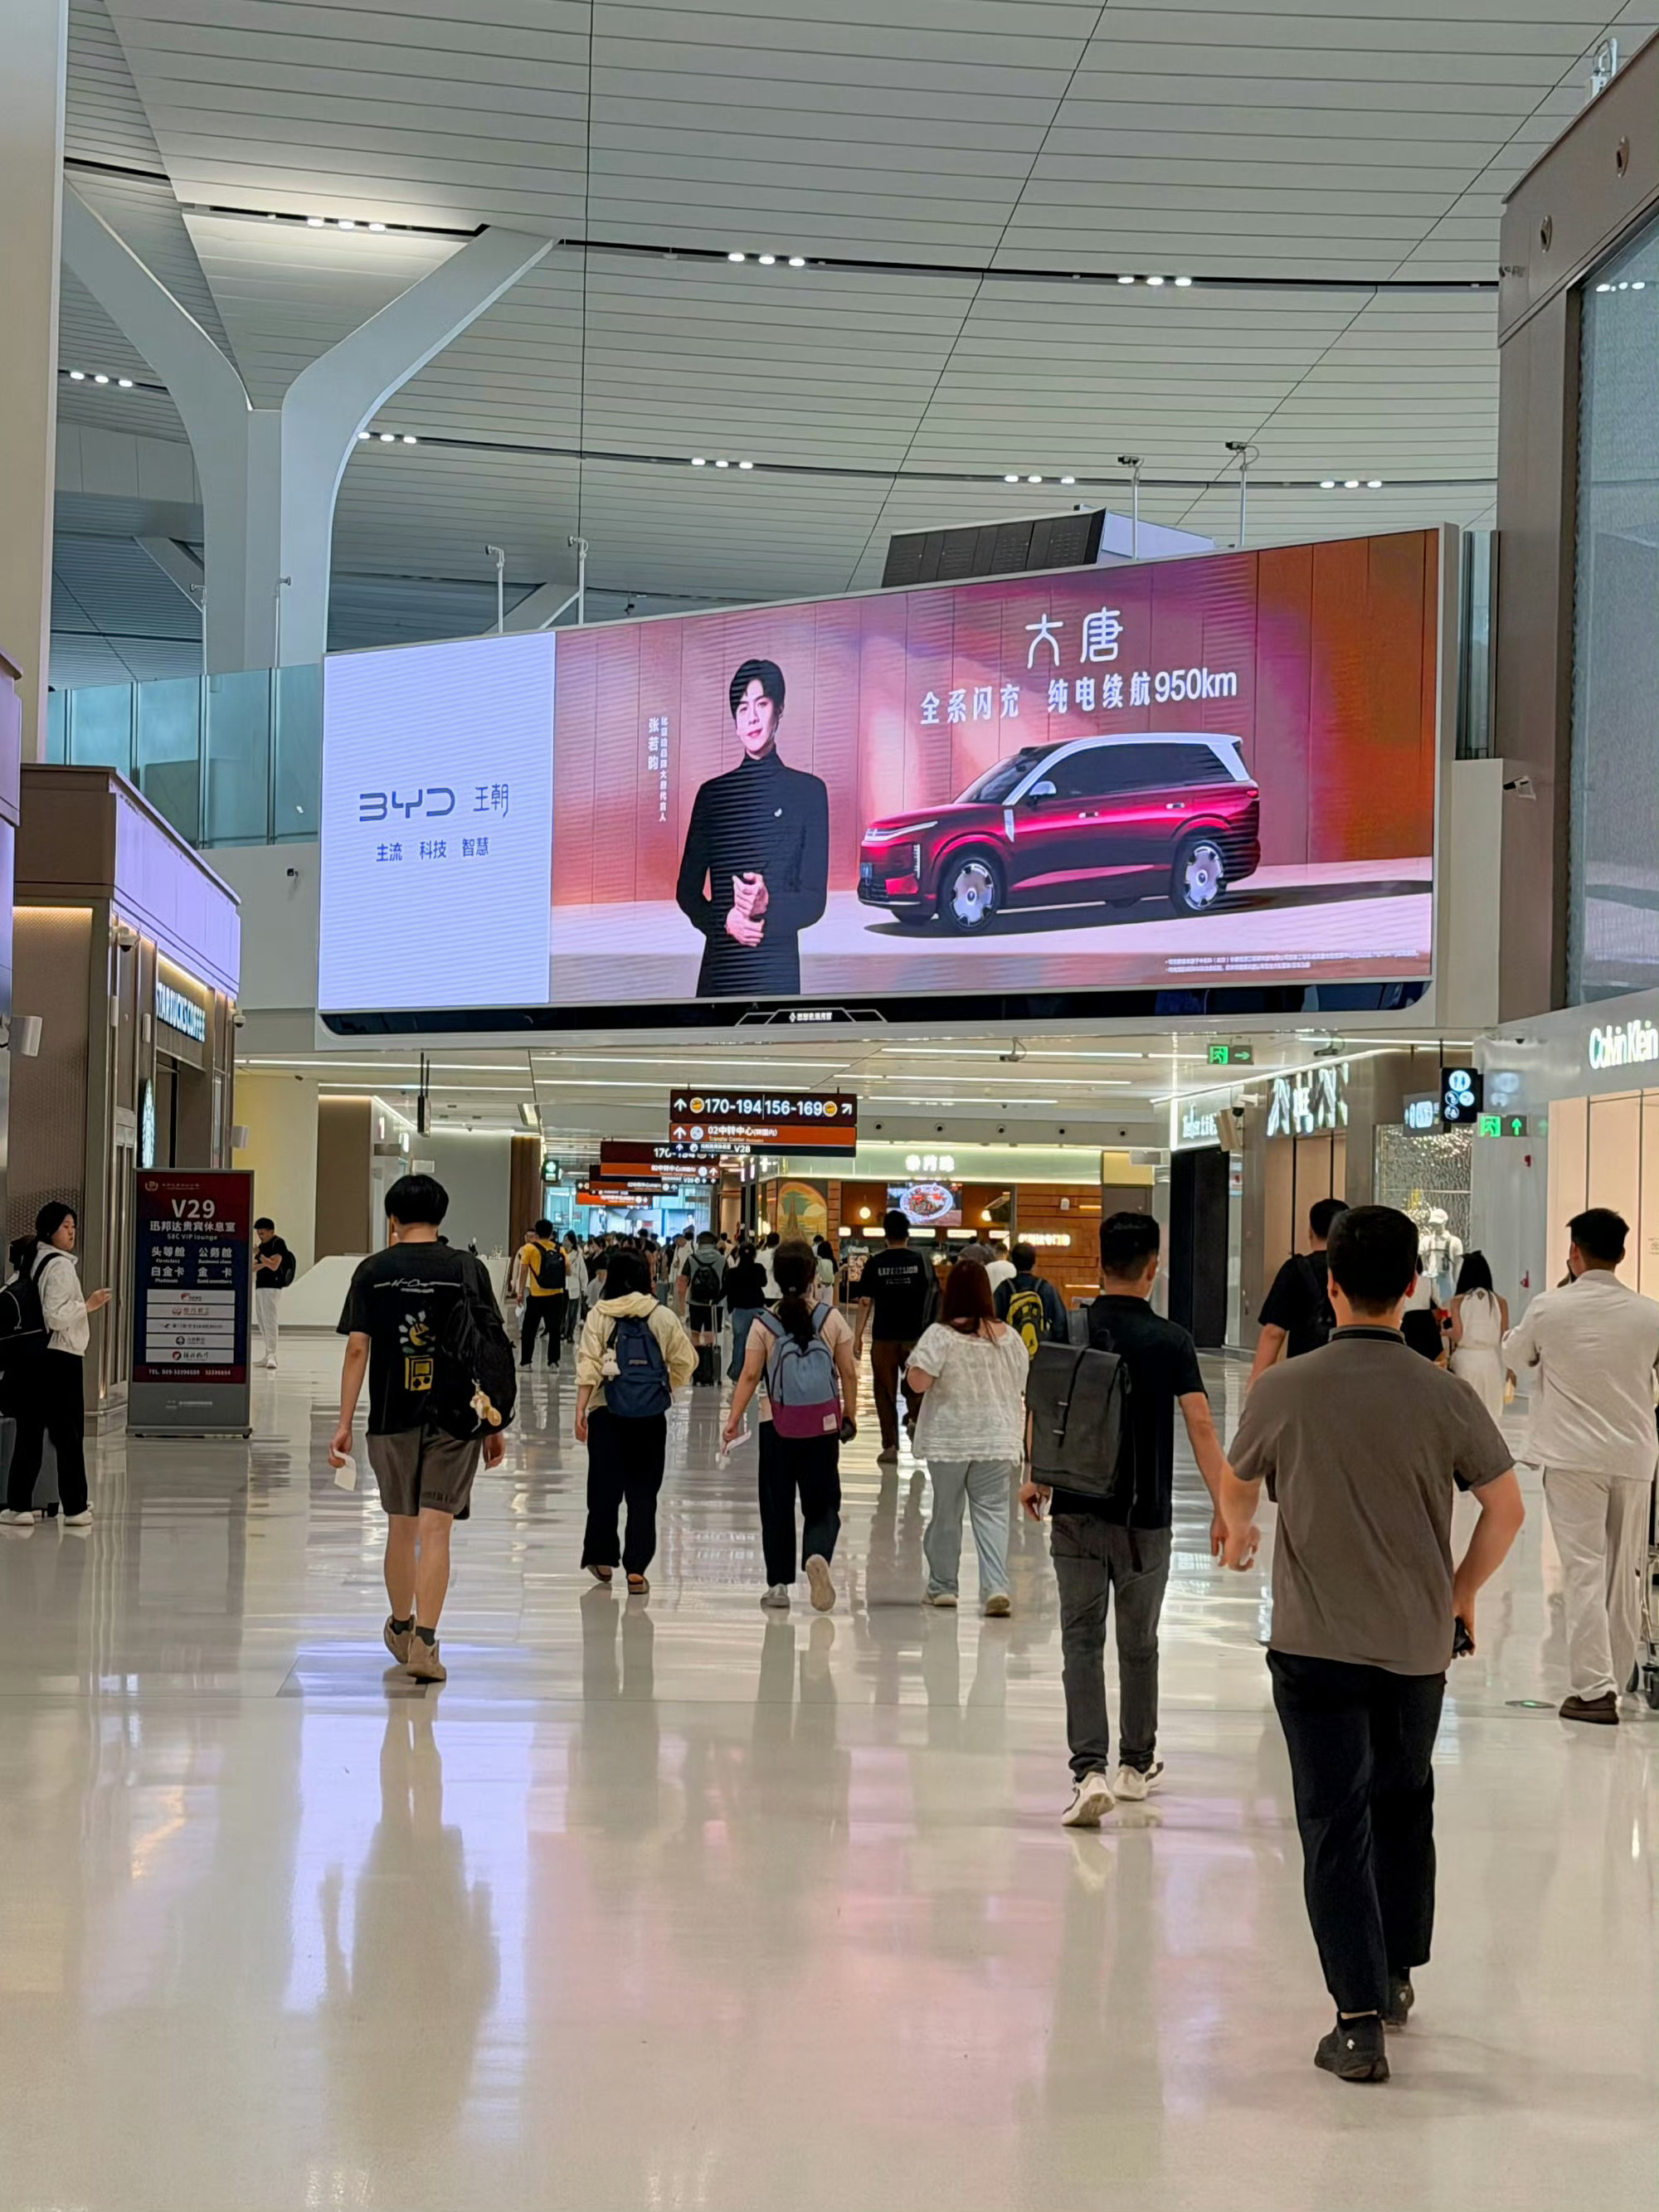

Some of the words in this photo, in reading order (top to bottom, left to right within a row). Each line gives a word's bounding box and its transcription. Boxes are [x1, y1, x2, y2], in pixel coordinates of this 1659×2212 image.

[1024, 606, 1124, 669] 大唐
[919, 683, 1021, 726] 全系闪充
[1047, 667, 1238, 714] 纯电续航950km
[359, 787, 455, 822] BYD
[473, 783, 509, 819] 王朝
[375, 842, 403, 863] 主流
[419, 839, 447, 860] 科技
[461, 837, 489, 858] 智慧
[1589, 1024, 1627, 1069] Calvin
[1627, 1019, 1658, 1063] Klein
[705, 1098, 762, 1114] 170-194
[765, 1100, 823, 1116] 156-169
[172, 1199, 215, 1218] V29
[193, 1233, 218, 1242] lounge
[151, 1246, 186, 1257] 头等舱
[198, 1247, 232, 1258] 公务舱
[151, 1266, 185, 1277] 白金卡
